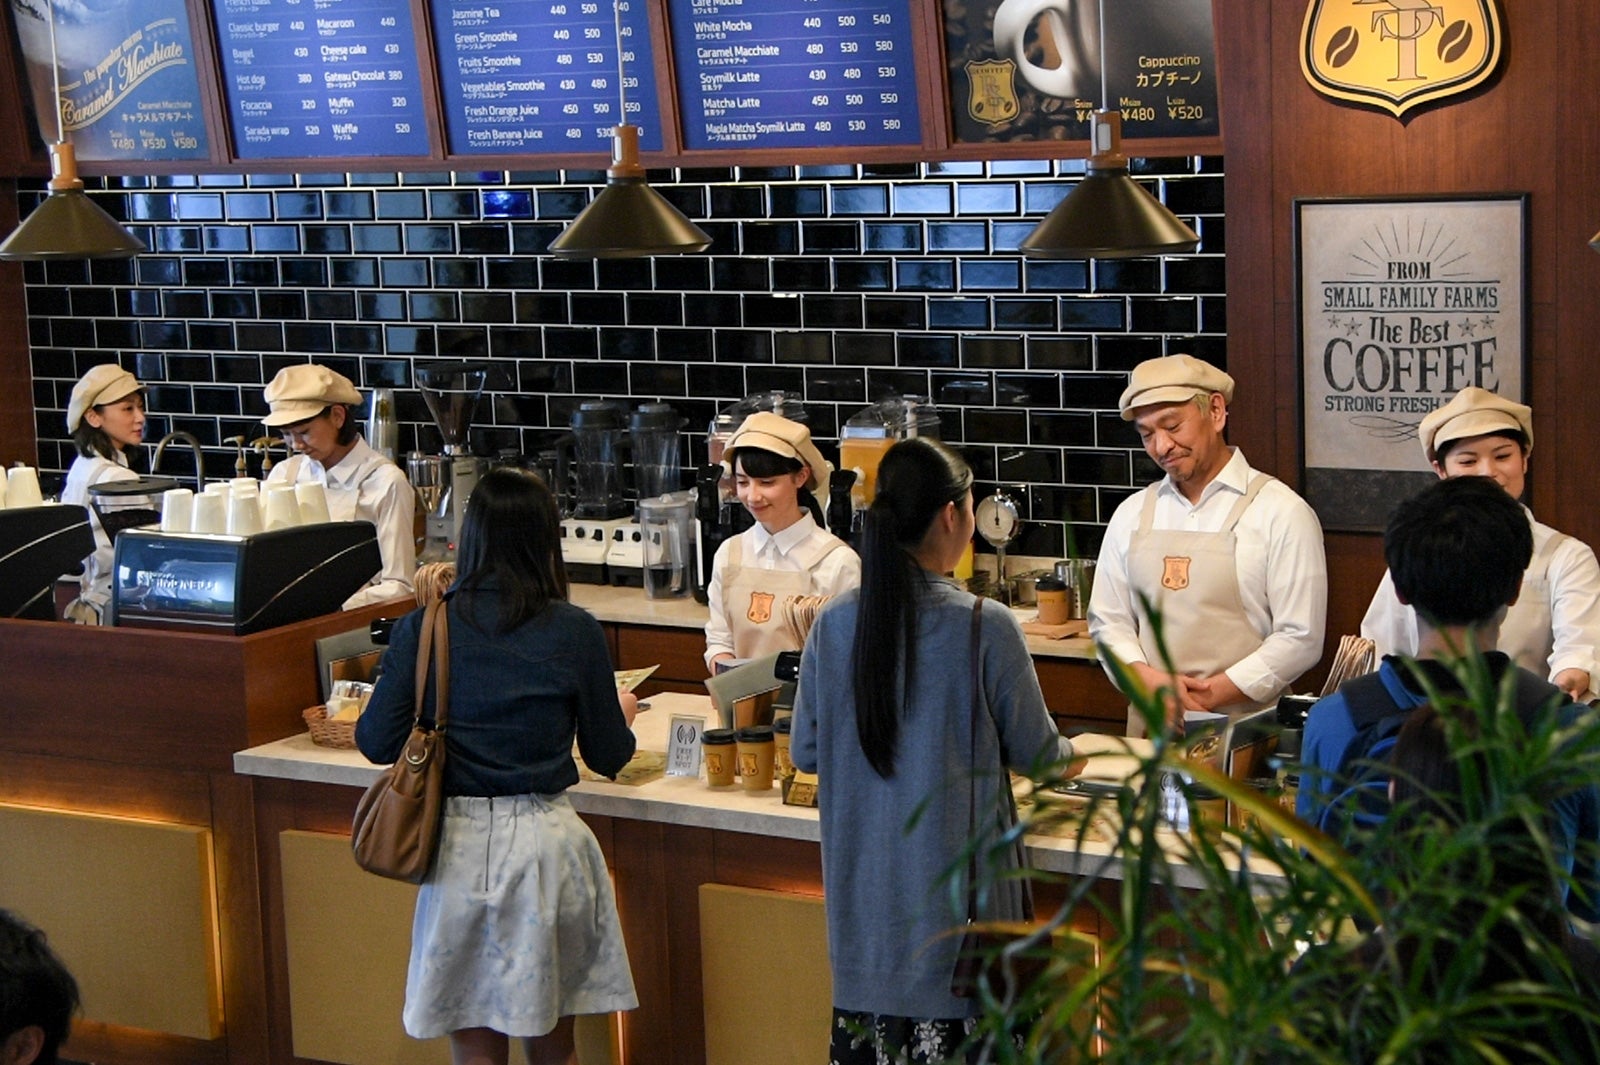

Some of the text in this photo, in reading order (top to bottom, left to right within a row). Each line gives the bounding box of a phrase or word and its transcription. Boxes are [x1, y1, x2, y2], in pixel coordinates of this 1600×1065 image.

[452, 9, 483, 20] Jasmine
[484, 7, 500, 18] Tea
[551, 5, 567, 15] 440
[581, 4, 598, 14] 500
[254, 21, 280, 33] burger
[290, 21, 305, 31] 440
[316, 17, 396, 29] Macaroon 440
[694, 14, 891, 33] White Mocha 440 500 540
[455, 33, 479, 44] Green
[479, 31, 518, 42] Smoothie
[554, 30, 570, 40] 440
[584, 28, 601, 38] 500
[294, 47, 309, 57] 430
[320, 44, 400, 56] Cheese cake 430
[697, 46, 733, 58] Caramel
[806, 44, 824, 54] 480
[841, 42, 859, 53] 530
[875, 41, 894, 51] 580
[458, 56, 482, 68] Fruits
[483, 55, 522, 67] Smoothie
[557, 54, 573, 65] 480
[587, 53, 604, 63] 530
[1138, 55, 1201, 68] Cappuccino
[236, 74, 250, 84] Hot
[351, 70, 386, 81] Chocolat
[388, 70, 403, 81] 380
[700, 67, 897, 85] Soymilk Latte 430 480 530
[1136, 70, 1201, 88] カプチーノ
[461, 78, 639, 93] Vegetables Smoothie 430 480 530
[301, 99, 316, 110] 320
[328, 97, 407, 108] Muffin 320
[703, 93, 899, 109] Matcha Latte 450 500 550
[465, 102, 641, 117] Fresh Orange Juice 450 500 550
[1121, 108, 1155, 121] ¥480
[1168, 106, 1203, 120] ¥520
[305, 125, 320, 136] 520
[332, 123, 410, 135] Waffle 520
[468, 130, 492, 140] Fresh
[492, 129, 522, 140] Banana
[523, 128, 544, 139] Juice
[566, 128, 582, 138] 480
[706, 119, 901, 135] Maple Matcha Soymilk Latte 480 530 580
[112, 137, 198, 150] ¥480 ¥530 ¥580
[1387, 262, 1431, 280] FROM
[1324, 287, 1498, 309] SMALL FAMILY FARMS
[1369, 316, 1450, 344] The Best
[1323, 337, 1500, 394] COFFEE
[1324, 395, 1385, 413] STRONG
[1389, 396, 1440, 413] FRESH
